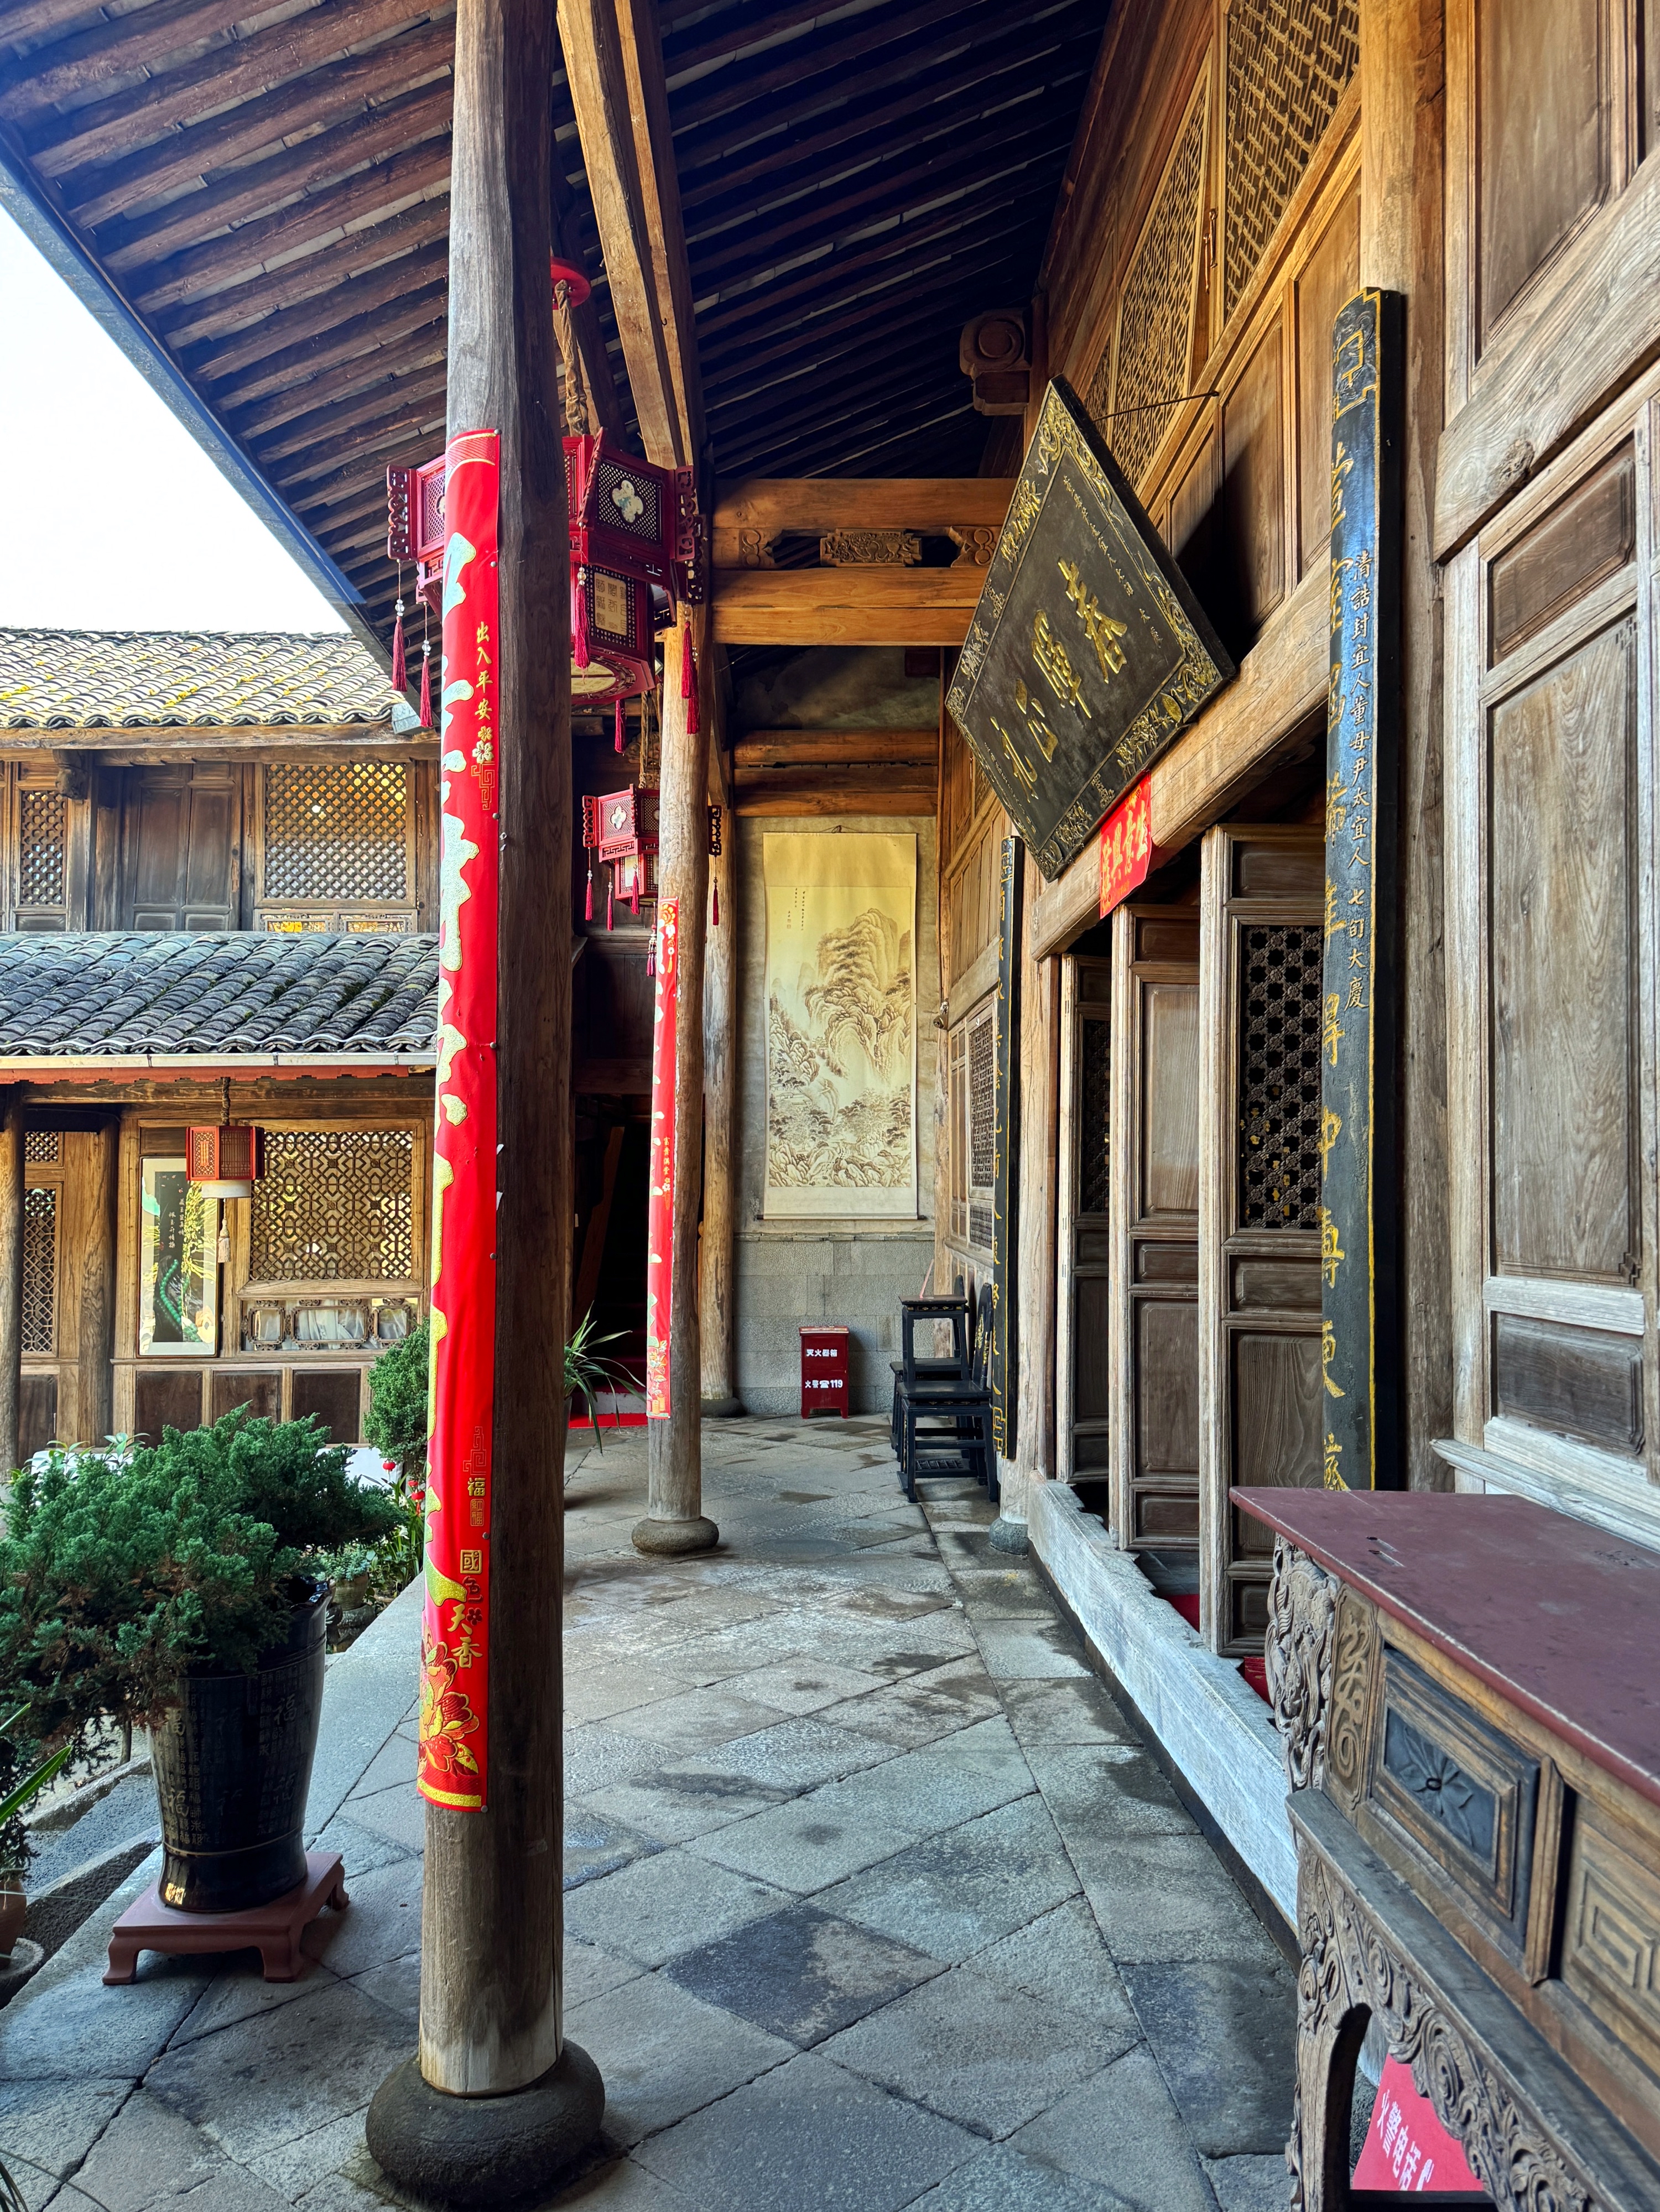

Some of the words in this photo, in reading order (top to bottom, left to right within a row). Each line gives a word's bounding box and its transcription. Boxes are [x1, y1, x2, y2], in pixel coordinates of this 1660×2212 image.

[475, 621, 493, 720] 出入平安
[806, 1349, 837, 1357] 灭火器箱
[805, 1380, 819, 1389] 火警
[830, 1379, 844, 1388] 119
[467, 1477, 486, 1496] 福
[447, 1550, 483, 1668] 國色天香
[168, 1787, 190, 1818] 福
